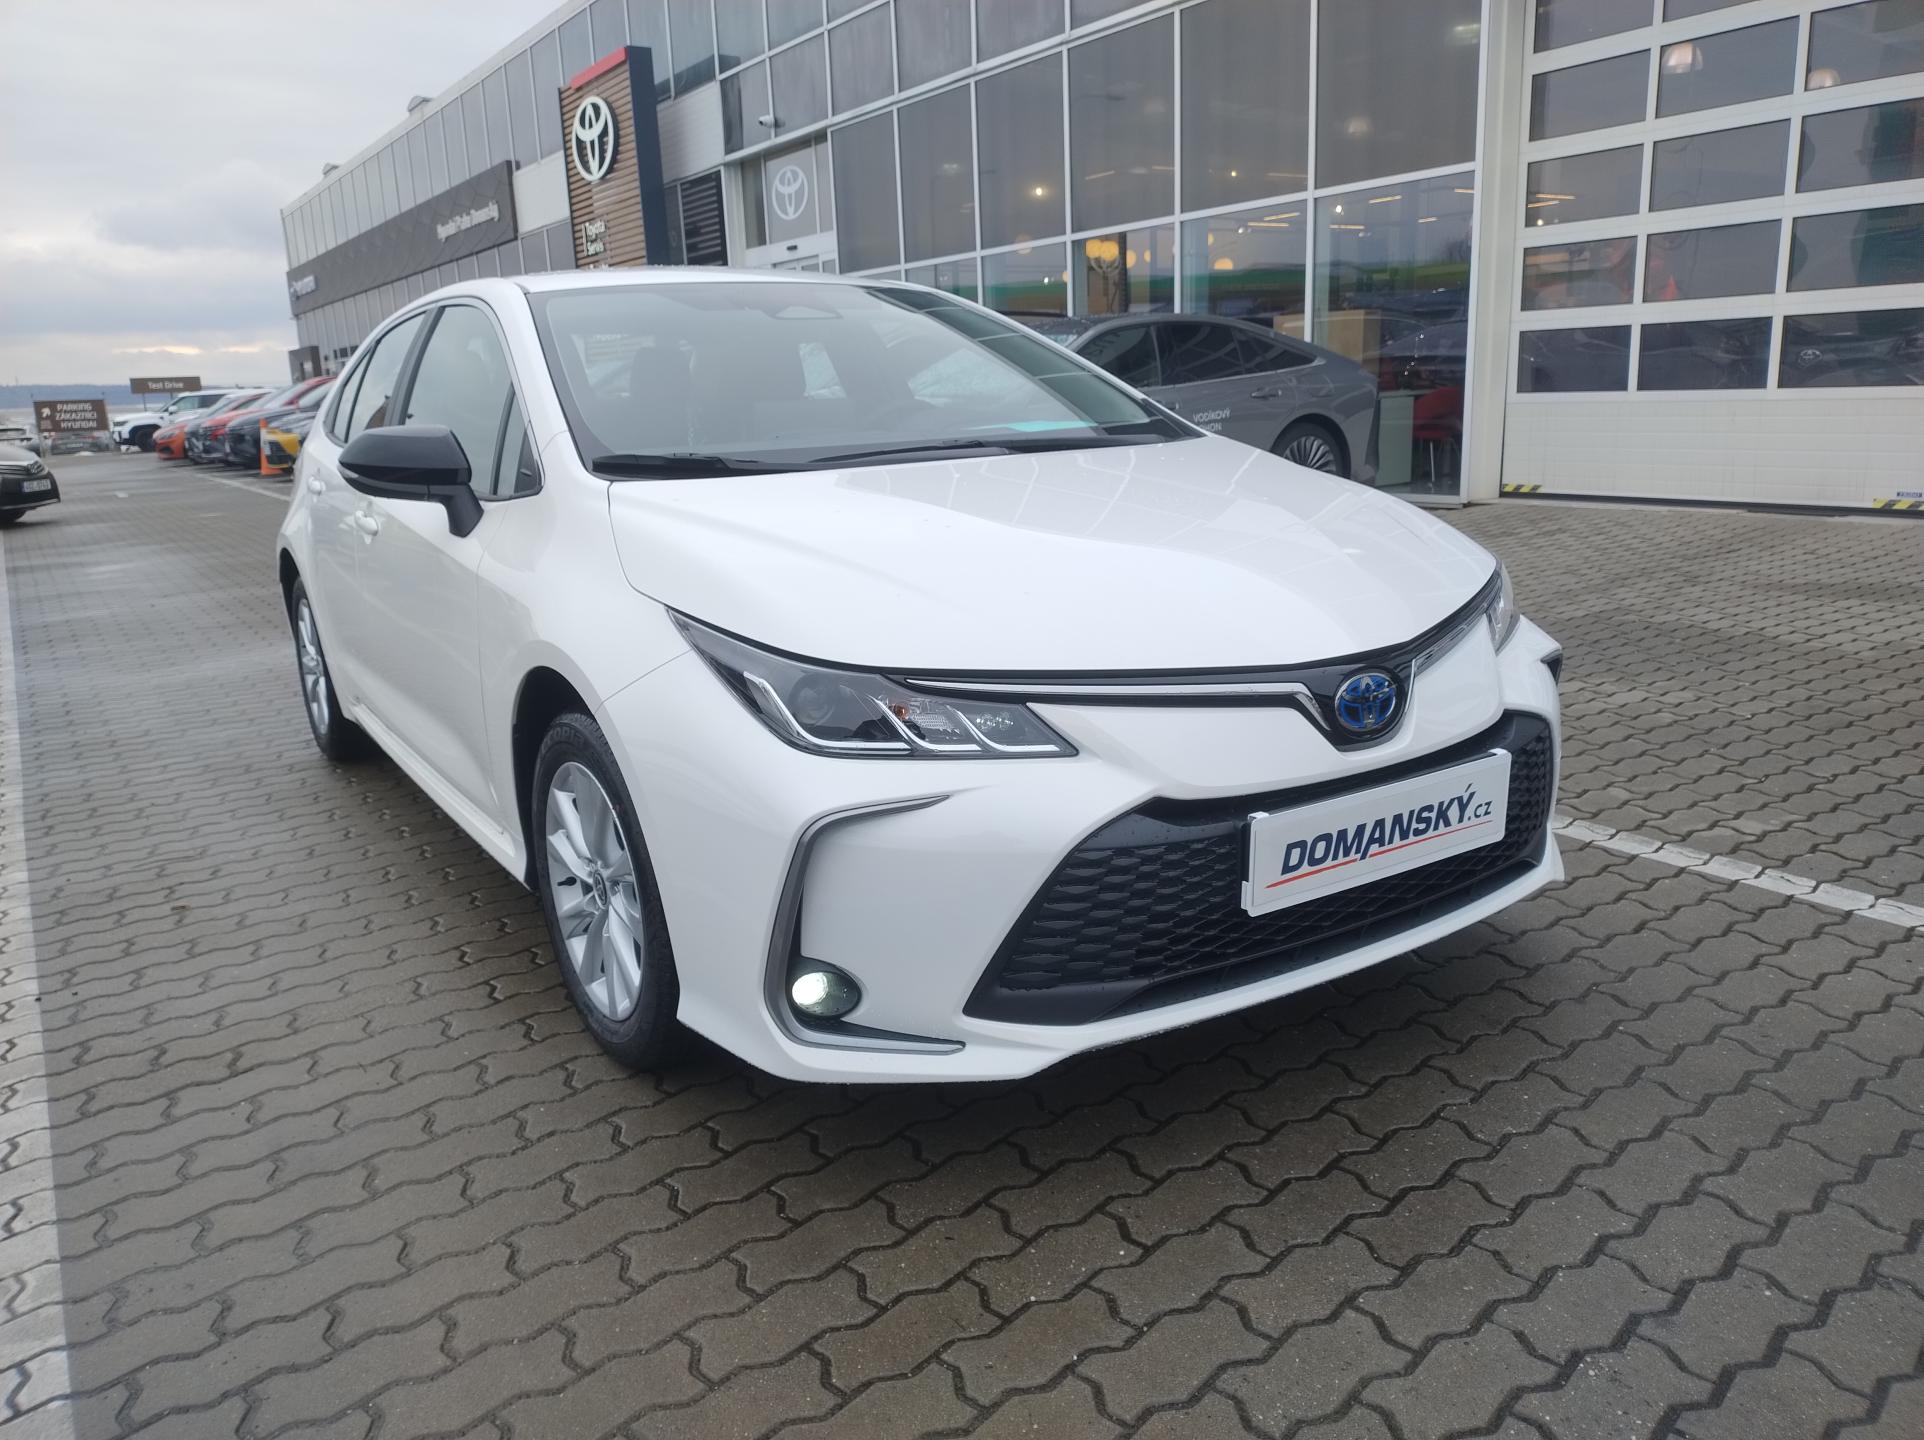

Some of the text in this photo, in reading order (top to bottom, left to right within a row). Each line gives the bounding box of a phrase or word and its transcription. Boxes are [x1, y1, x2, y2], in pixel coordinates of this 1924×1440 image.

[57, 402, 92, 412] PARKING
[61, 420, 97, 430] HYUNDAI
[1200, 422, 1222, 431] OHON
